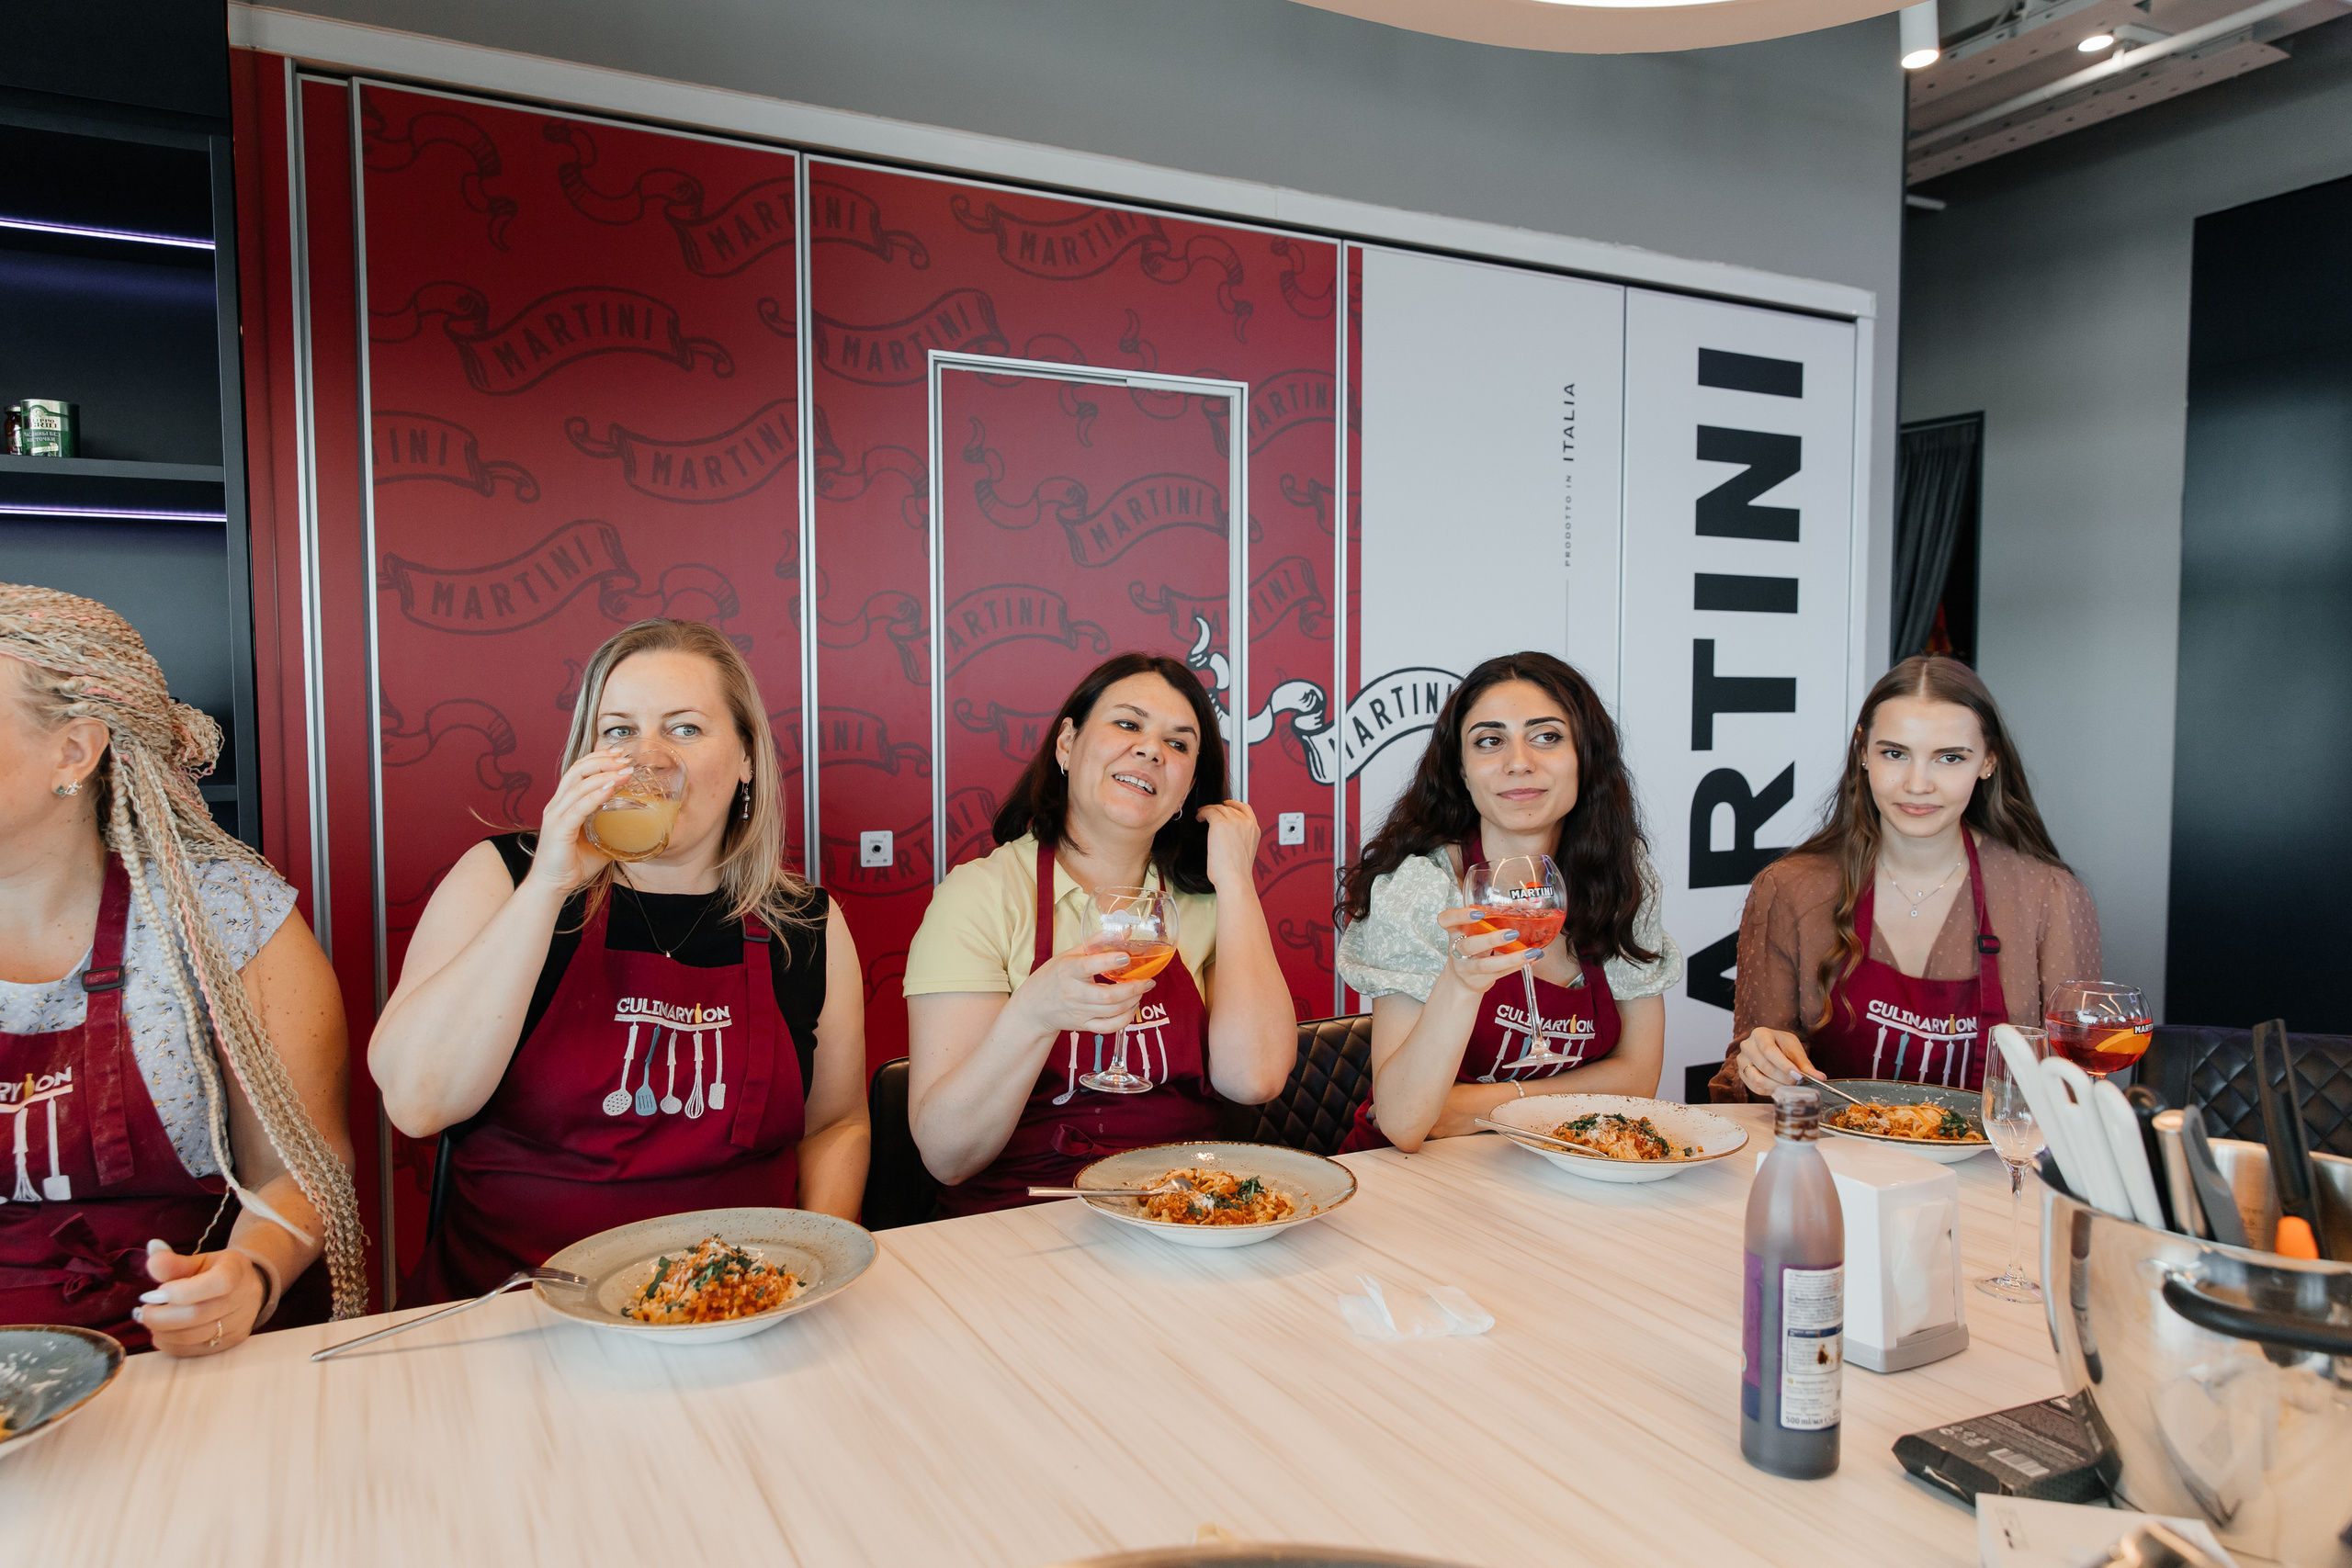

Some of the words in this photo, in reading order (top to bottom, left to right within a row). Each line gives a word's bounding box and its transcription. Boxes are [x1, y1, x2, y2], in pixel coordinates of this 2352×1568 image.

[492, 301, 653, 378] MARTINI
[842, 301, 971, 374] MARTINI
[1247, 382, 1335, 440] ARTIN
[1563, 383, 1575, 461] ITALIA
[650, 418, 796, 491] MARTINI
[1566, 475, 1572, 488] IN
[1089, 486, 1203, 553] MARTINI
[431, 535, 594, 621] MARTINI
[1189, 569, 1296, 637] MATINI
[1511, 886, 1554, 899] MARTINI
